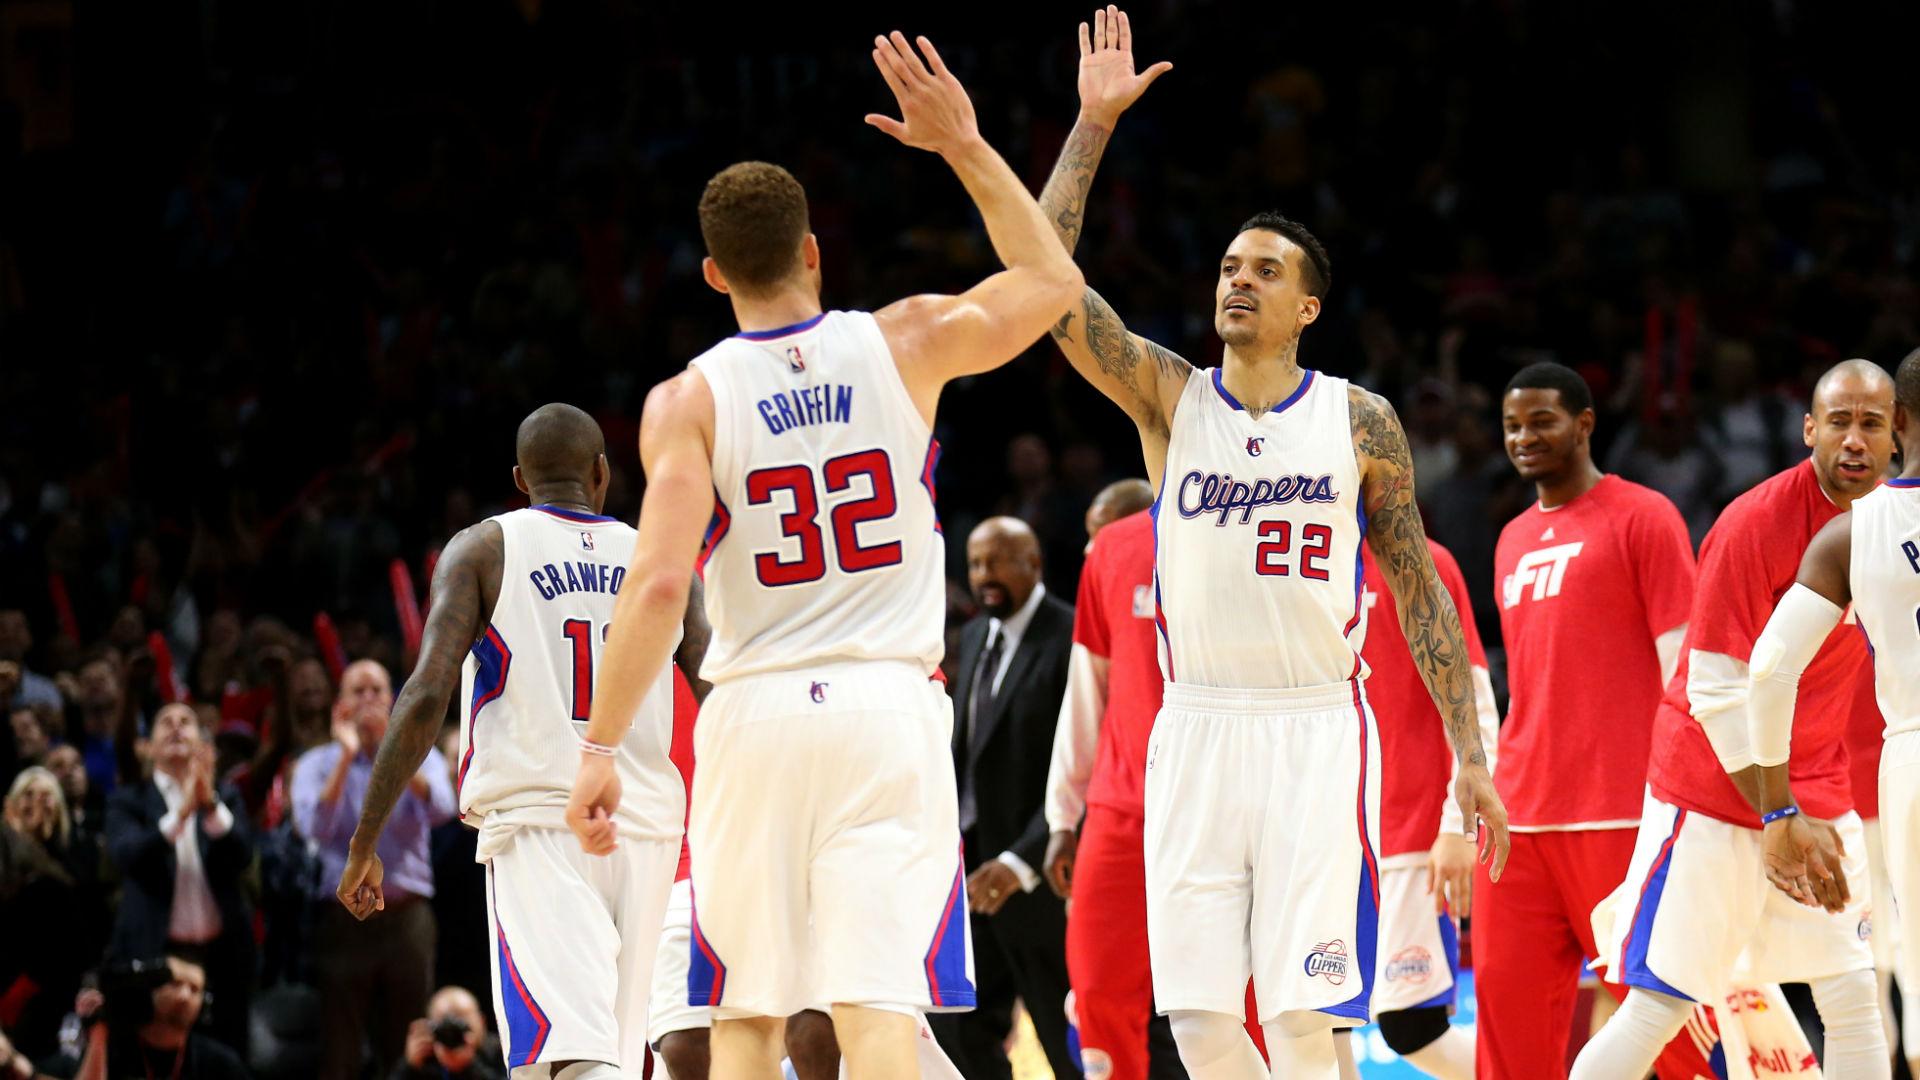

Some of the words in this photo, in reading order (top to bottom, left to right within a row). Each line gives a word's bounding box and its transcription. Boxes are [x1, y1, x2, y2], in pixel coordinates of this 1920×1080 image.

[757, 384, 853, 435] GRIFFIN
[745, 448, 903, 588] 32
[1178, 468, 1339, 526] Clippers
[1256, 520, 1332, 581] 22
[1901, 540, 1920, 574] P
[530, 561, 627, 600] CRAWFO
[563, 618, 612, 721] 1
